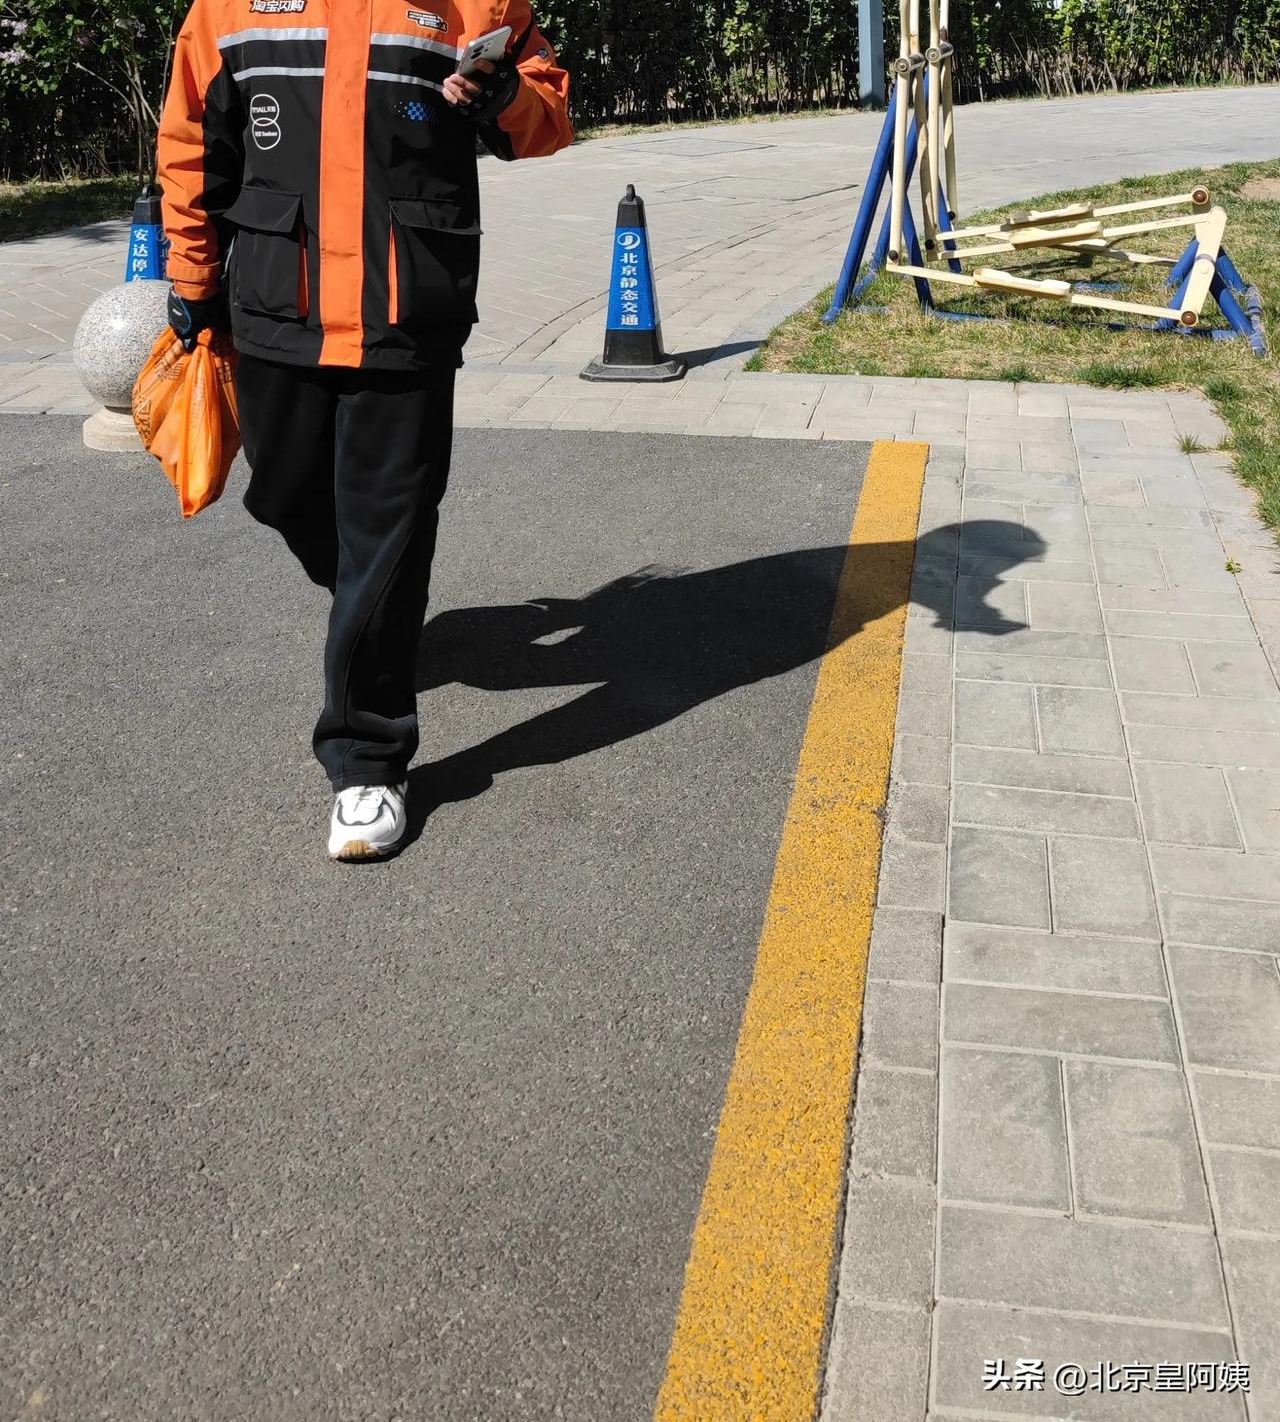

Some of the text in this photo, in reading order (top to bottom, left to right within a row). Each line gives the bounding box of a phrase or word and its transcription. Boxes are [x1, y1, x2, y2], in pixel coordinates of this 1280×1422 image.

[251, 0, 305, 12] 淘宝闪购
[620, 252, 639, 326] 北京静态交通
